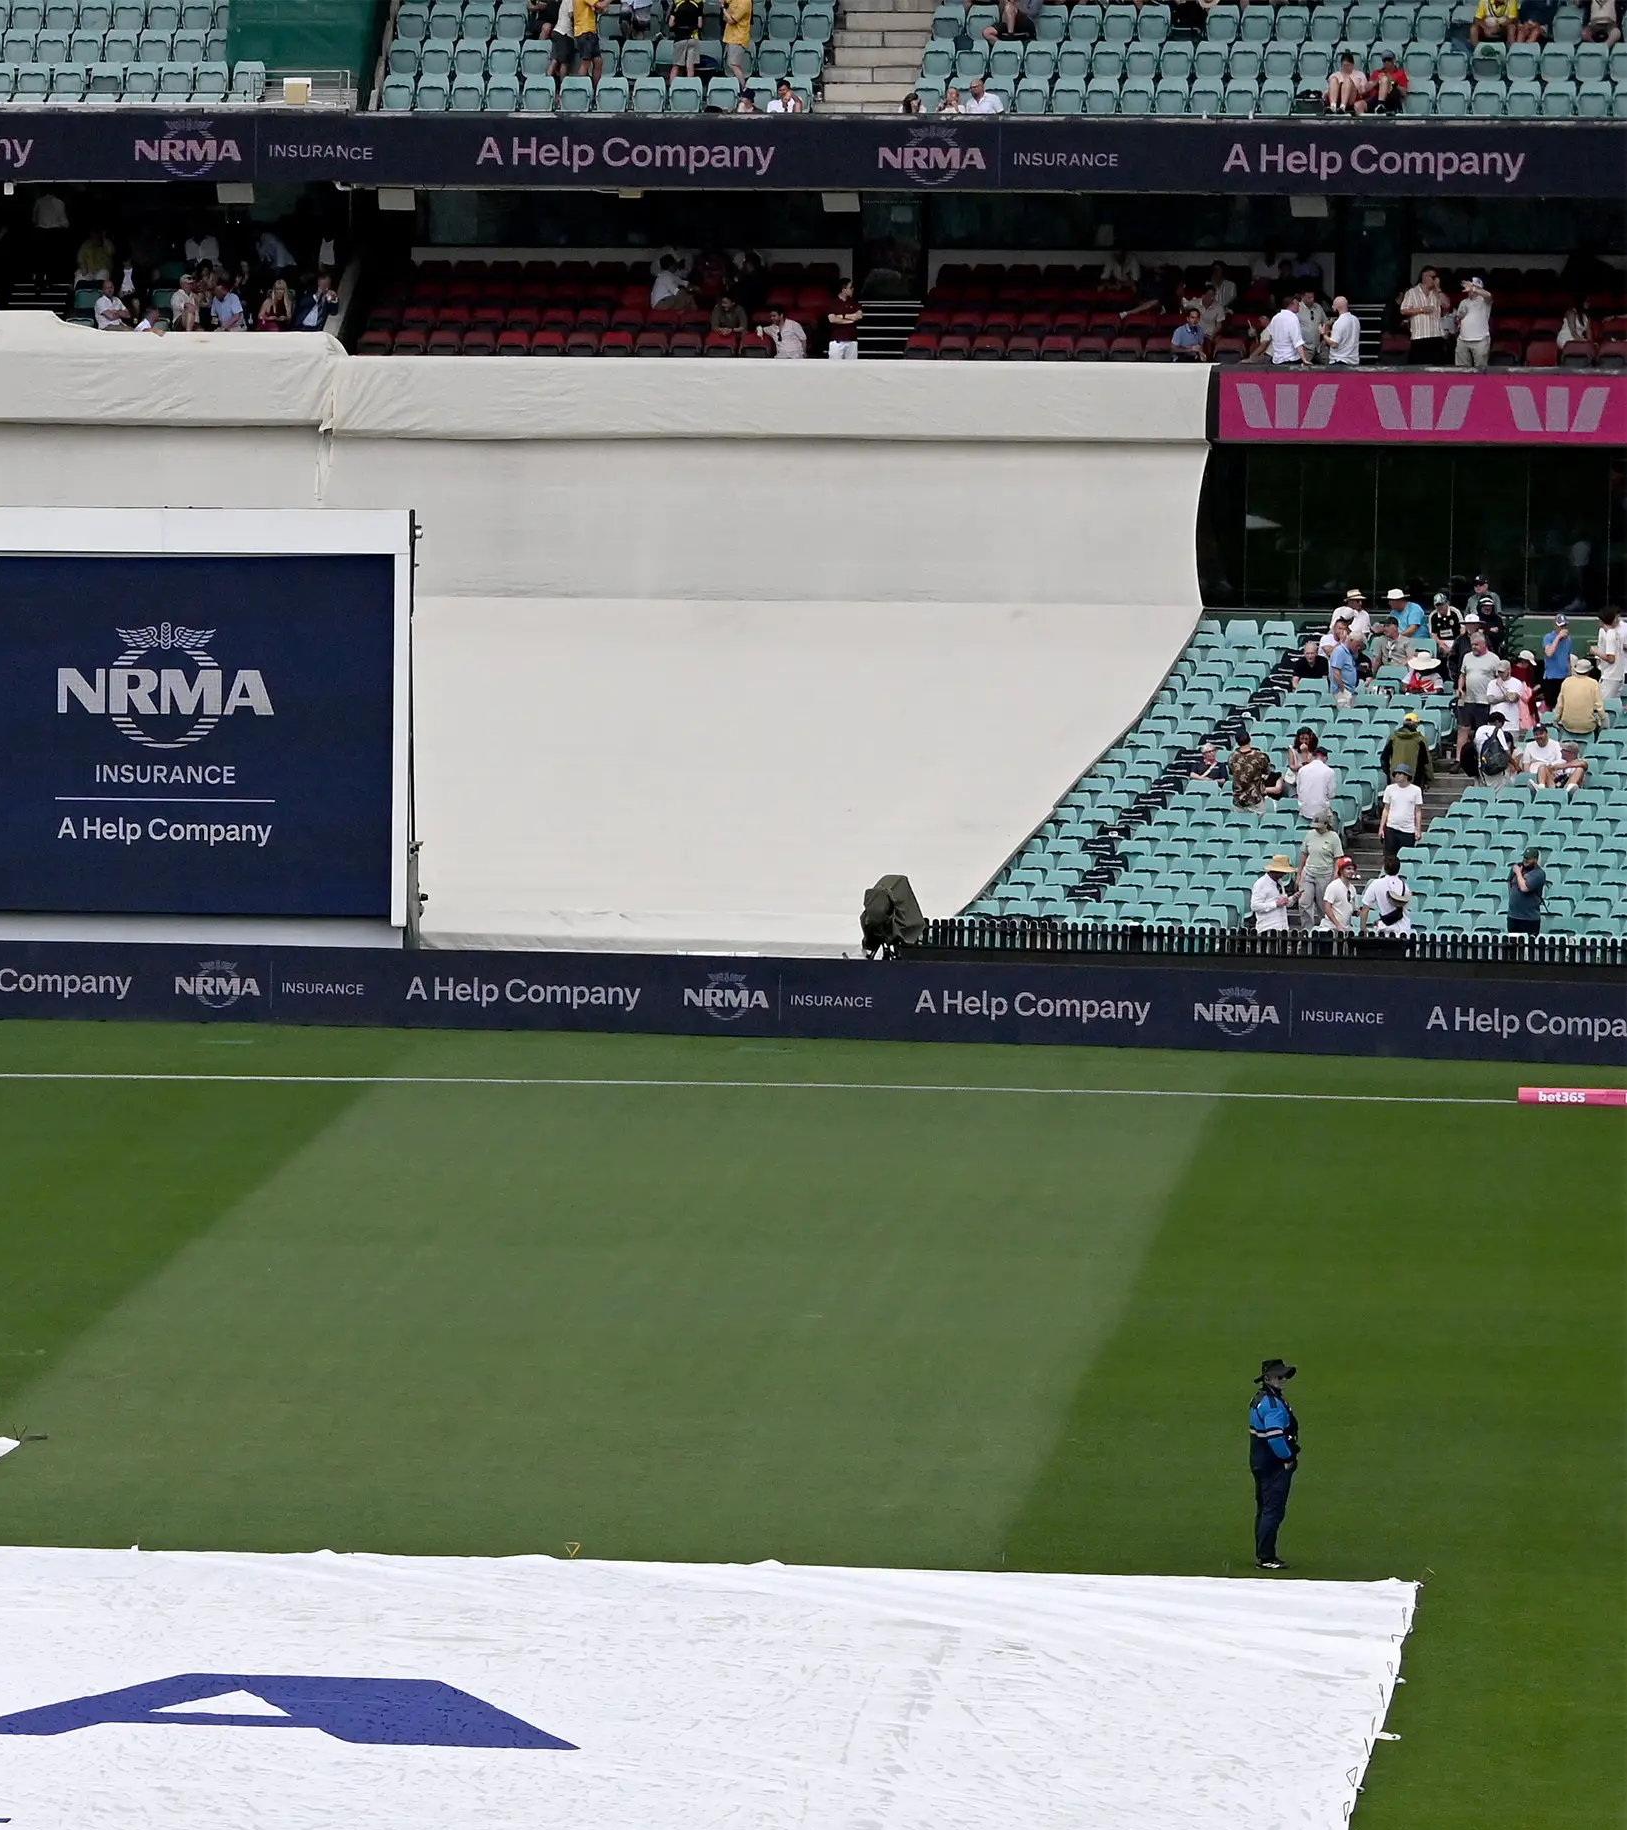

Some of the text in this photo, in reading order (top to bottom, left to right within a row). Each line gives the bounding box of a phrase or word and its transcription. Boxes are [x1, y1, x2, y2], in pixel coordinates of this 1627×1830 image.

[134, 139, 373, 161] NRMA INSURANCE
[477, 137, 775, 175] A Help Company
[878, 147, 1118, 169] NRMA INSURANCE
[1223, 144, 1525, 181] A Help Company
[57, 667, 276, 717] NRMA
[95, 764, 236, 785] INSURANCE
[58, 816, 273, 847] A Help Company
[175, 976, 364, 996] NRMA INSURANCE
[406, 977, 641, 1012] A Help Company
[684, 989, 873, 1008] NRMA INSURANCE
[915, 990, 1151, 1026] A Help Company
[1193, 1002, 1384, 1025] NRMA INSURANCE
[1427, 1006, 1448, 1031] A
[1455, 1007, 1520, 1039] Help
[1538, 1090, 1586, 1103] bet365
